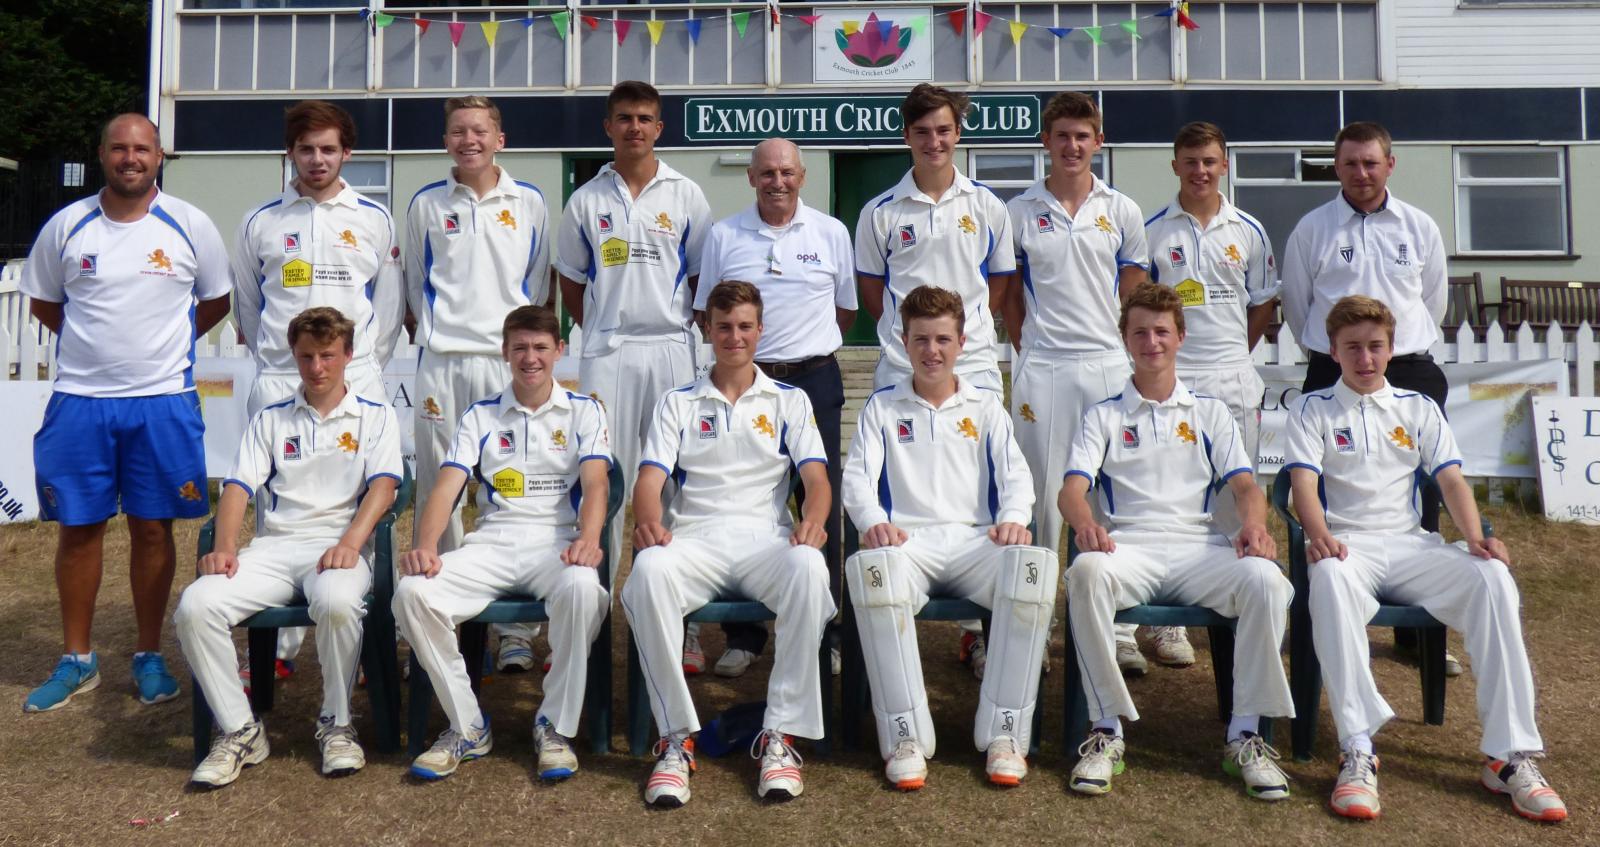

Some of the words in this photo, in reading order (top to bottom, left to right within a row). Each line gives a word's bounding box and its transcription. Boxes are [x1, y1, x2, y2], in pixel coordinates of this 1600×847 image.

[832, 62, 860, 76] Exmouth
[884, 67, 899, 75] Club
[696, 103, 827, 133] EXMOUTH
[834, 102, 904, 132] CRIC
[961, 101, 1031, 131] CLUB
